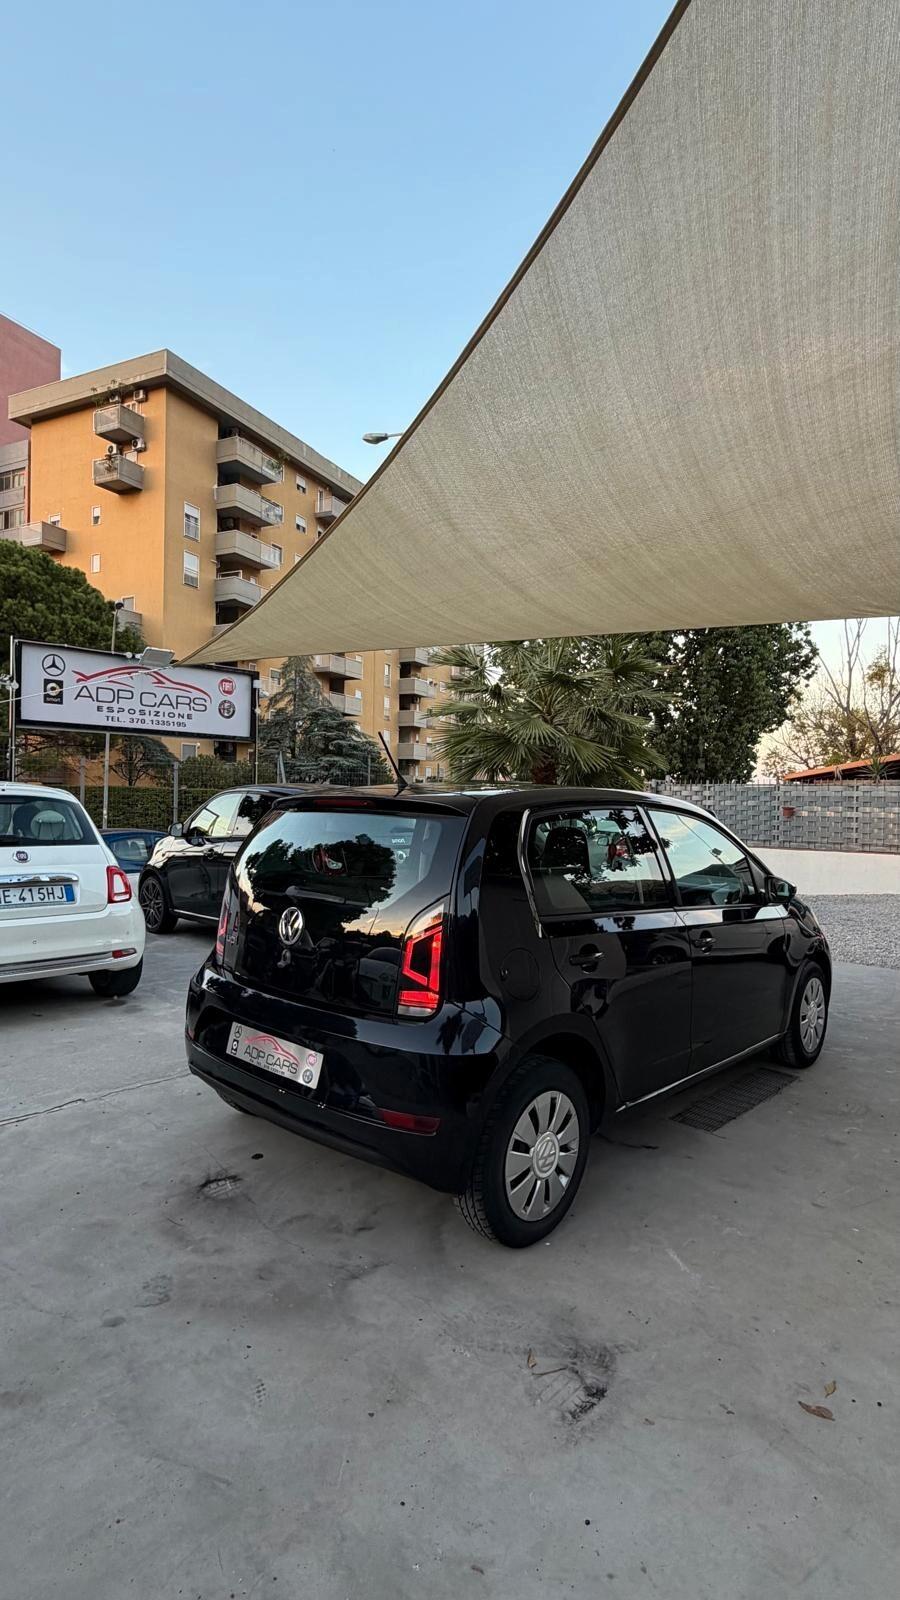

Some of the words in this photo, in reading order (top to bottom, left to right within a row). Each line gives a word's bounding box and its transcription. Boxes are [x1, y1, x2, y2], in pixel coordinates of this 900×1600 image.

[74, 685, 134, 705] ADP
[139, 691, 208, 713] CARS
[96, 705, 193, 720] ESPOSIZIONE
[105, 715, 126, 723] TEL.
[129, 717, 187, 728] 370.1335195
[244, 1045, 265, 1060] ADP
[265, 1053, 299, 1075] CARS
